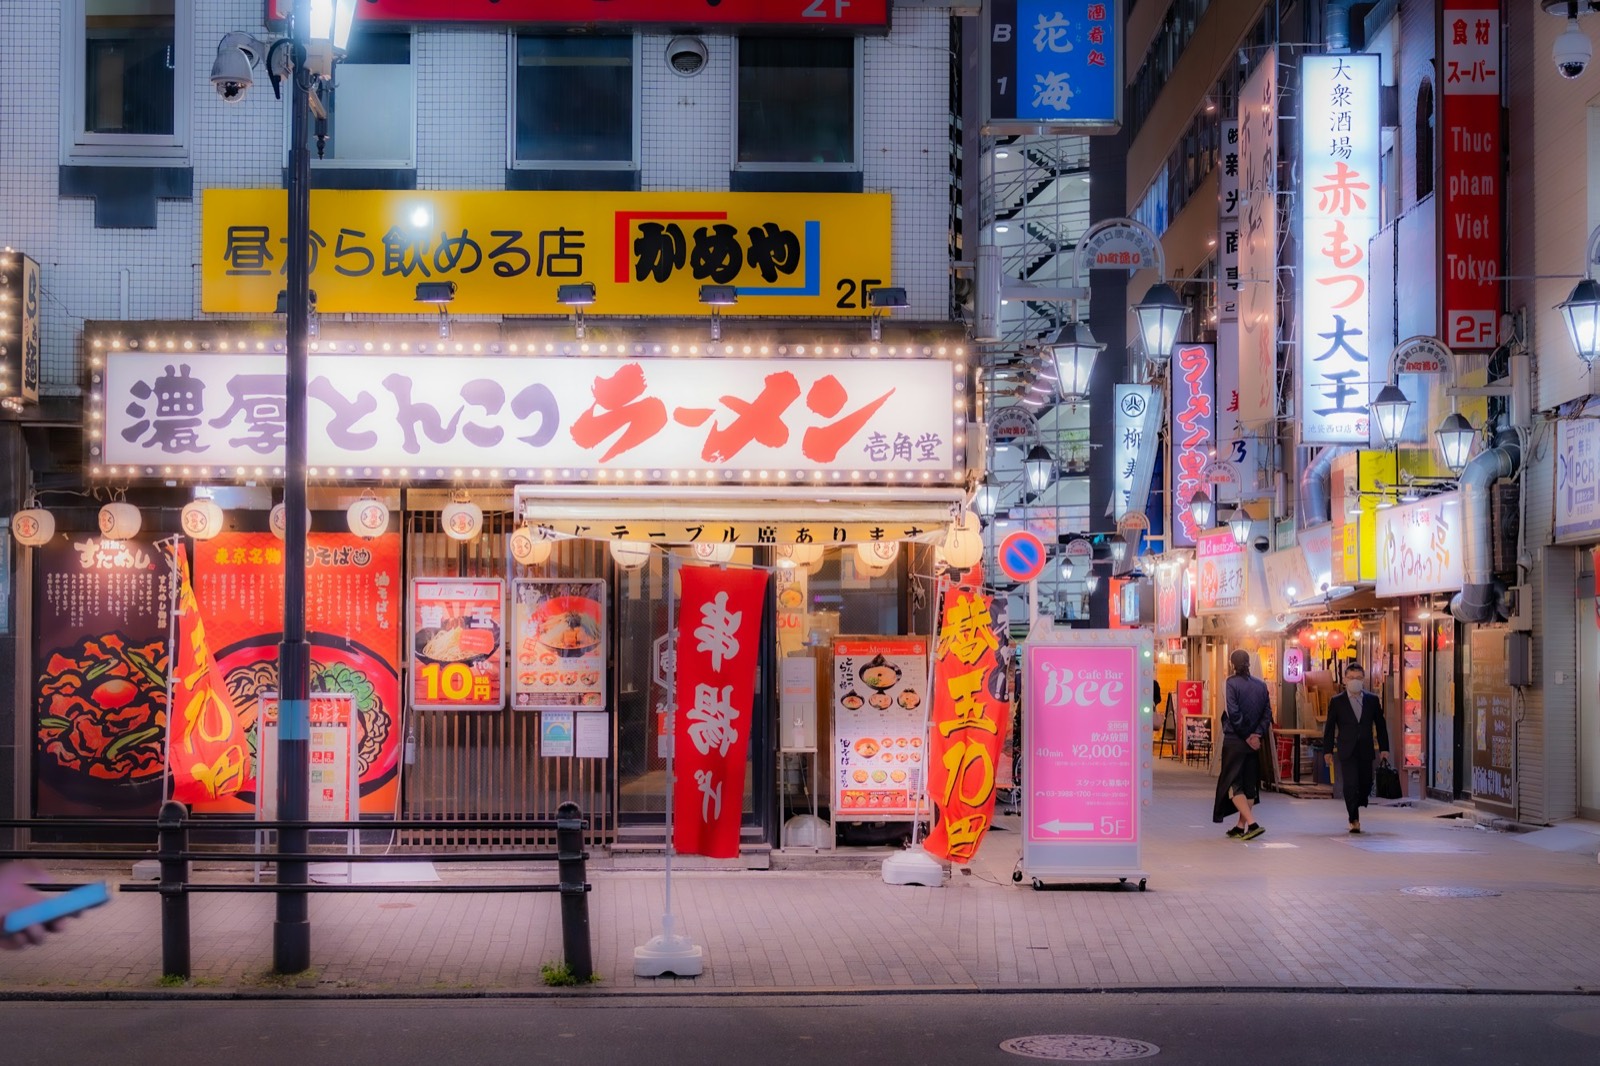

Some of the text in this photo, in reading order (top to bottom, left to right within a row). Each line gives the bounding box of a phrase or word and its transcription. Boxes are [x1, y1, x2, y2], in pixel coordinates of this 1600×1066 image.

[1453, 18, 1491, 46] 食材
[1032, 12, 1074, 111] 花海
[1448, 60, 1496, 83] スーパー
[1329, 58, 1352, 160] 大衆酒場
[1451, 127, 1492, 152] Thuc
[1450, 170, 1494, 201] pham
[1455, 213, 1489, 239] Viet
[223, 225, 587, 279] 昼から飲める店
[633, 222, 800, 284] かめや
[1448, 254, 1497, 287] Tokyo
[836, 278, 882, 310] 2F
[1312, 162, 1370, 417] 赤もつ大王
[1455, 315, 1492, 342] 2F
[864, 431, 943, 463] 壱角堂
[1575, 458, 1595, 487] PCR
[215, 547, 282, 565] 東京名物
[1041, 662, 1123, 707] Bee
[1078, 669, 1123, 680] Cafe Bar
[1100, 816, 1126, 836] 5F
